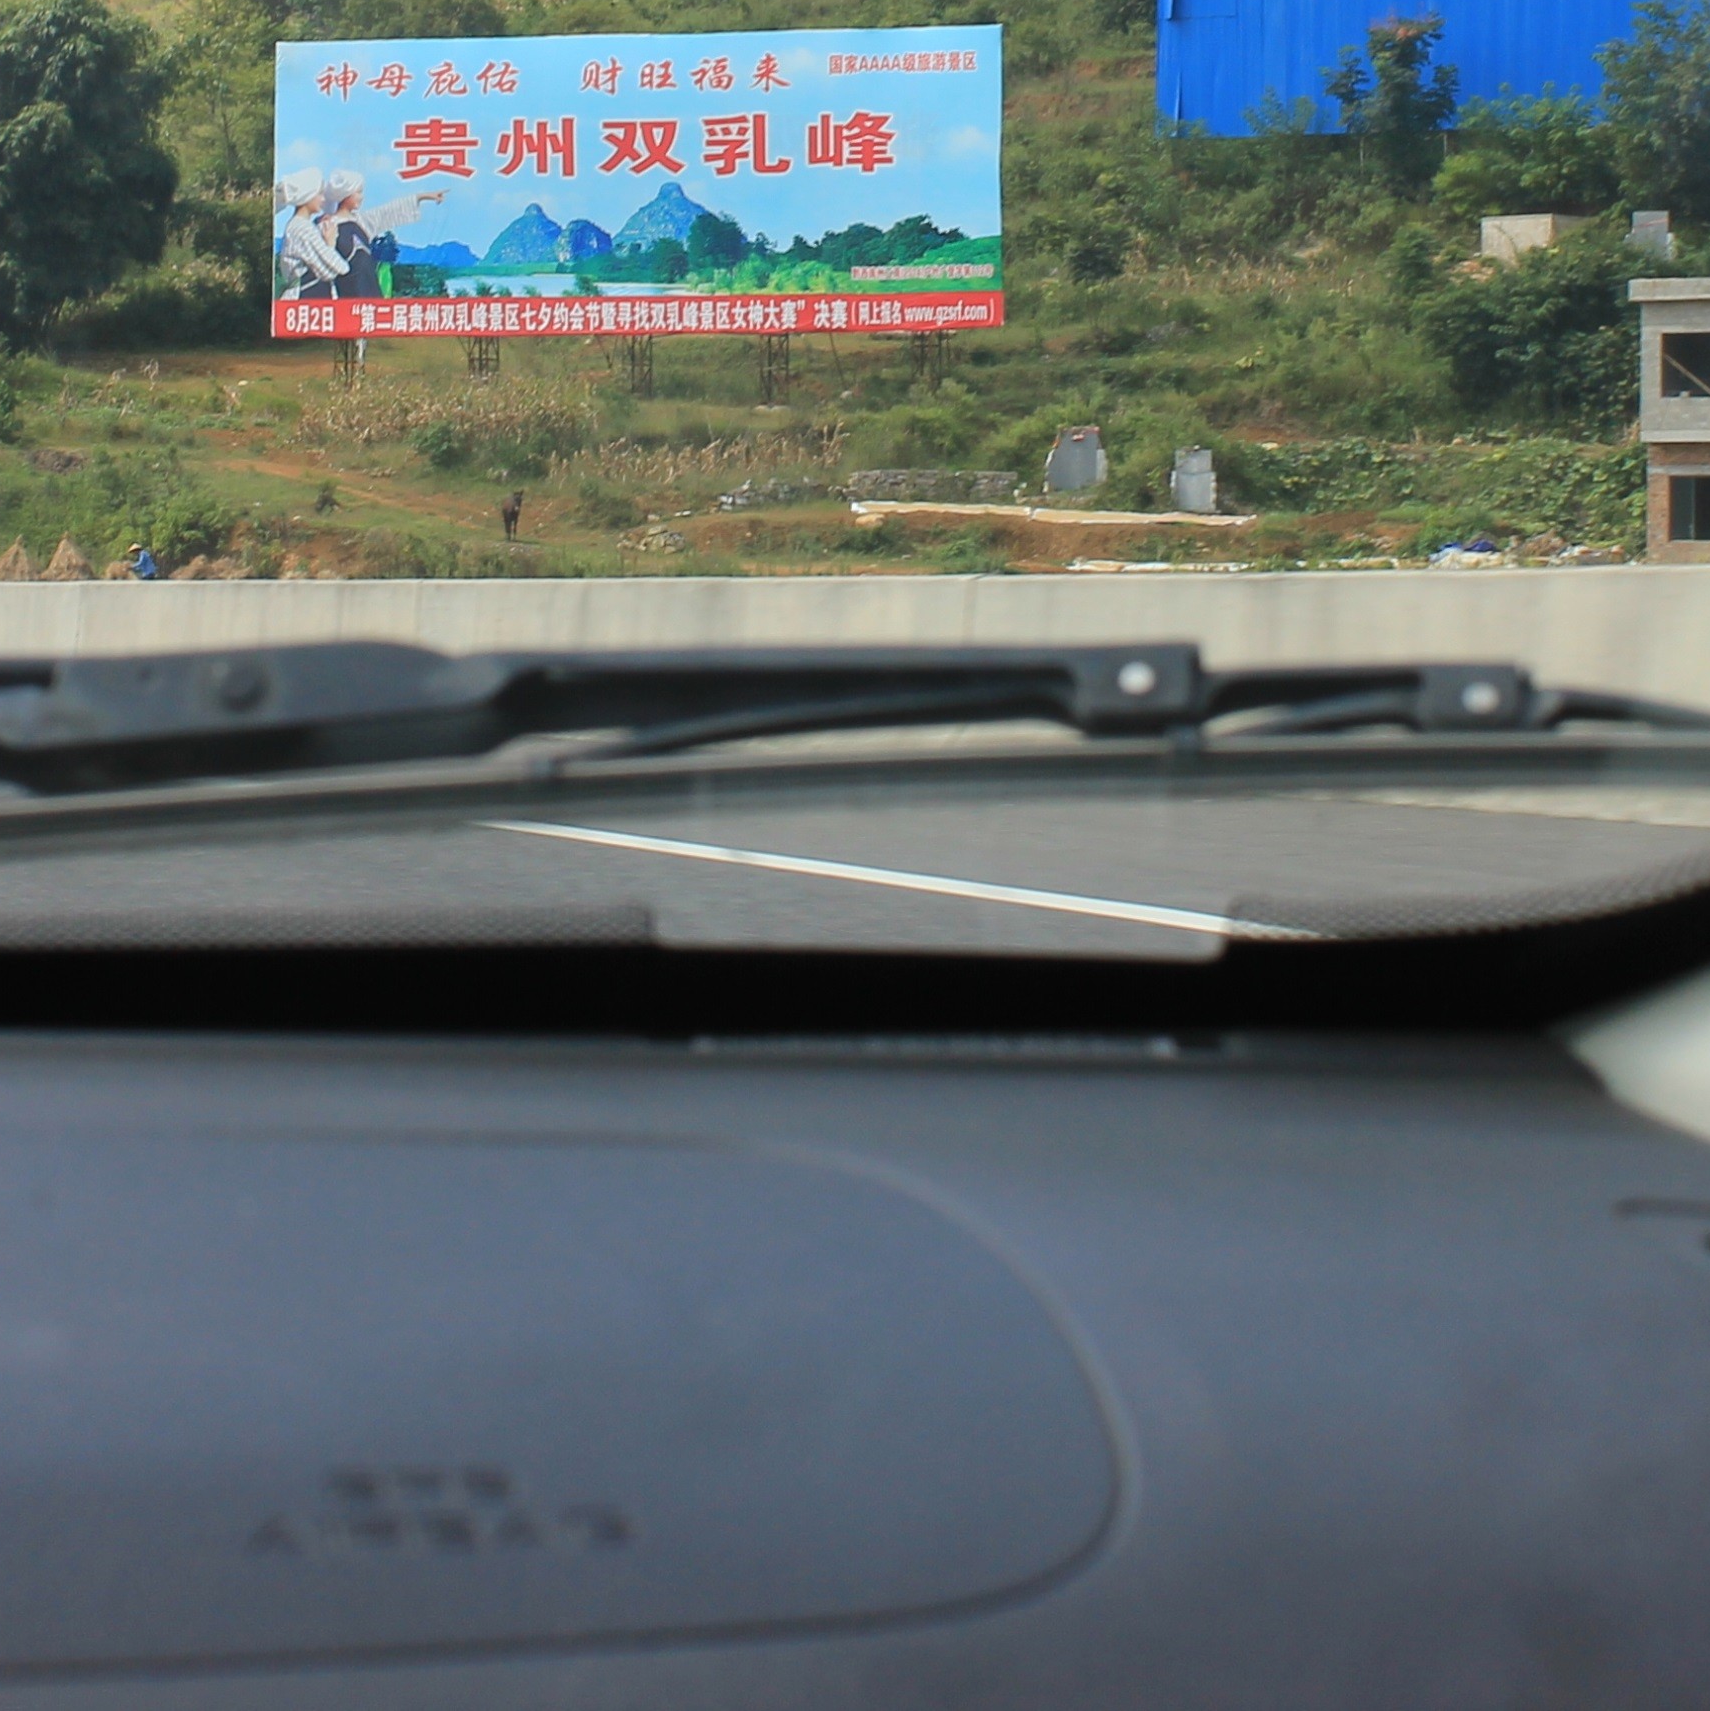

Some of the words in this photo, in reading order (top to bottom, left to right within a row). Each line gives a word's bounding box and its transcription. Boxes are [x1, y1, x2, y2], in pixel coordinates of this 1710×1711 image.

[316, 61, 520, 103] 神母庇佑
[580, 54, 791, 95] 财旺福来
[828, 50, 978, 76] 国家AAAA级旅游景区
[393, 110, 897, 180] 贵州双乳峰
[286, 304, 334, 333] 8月2日
